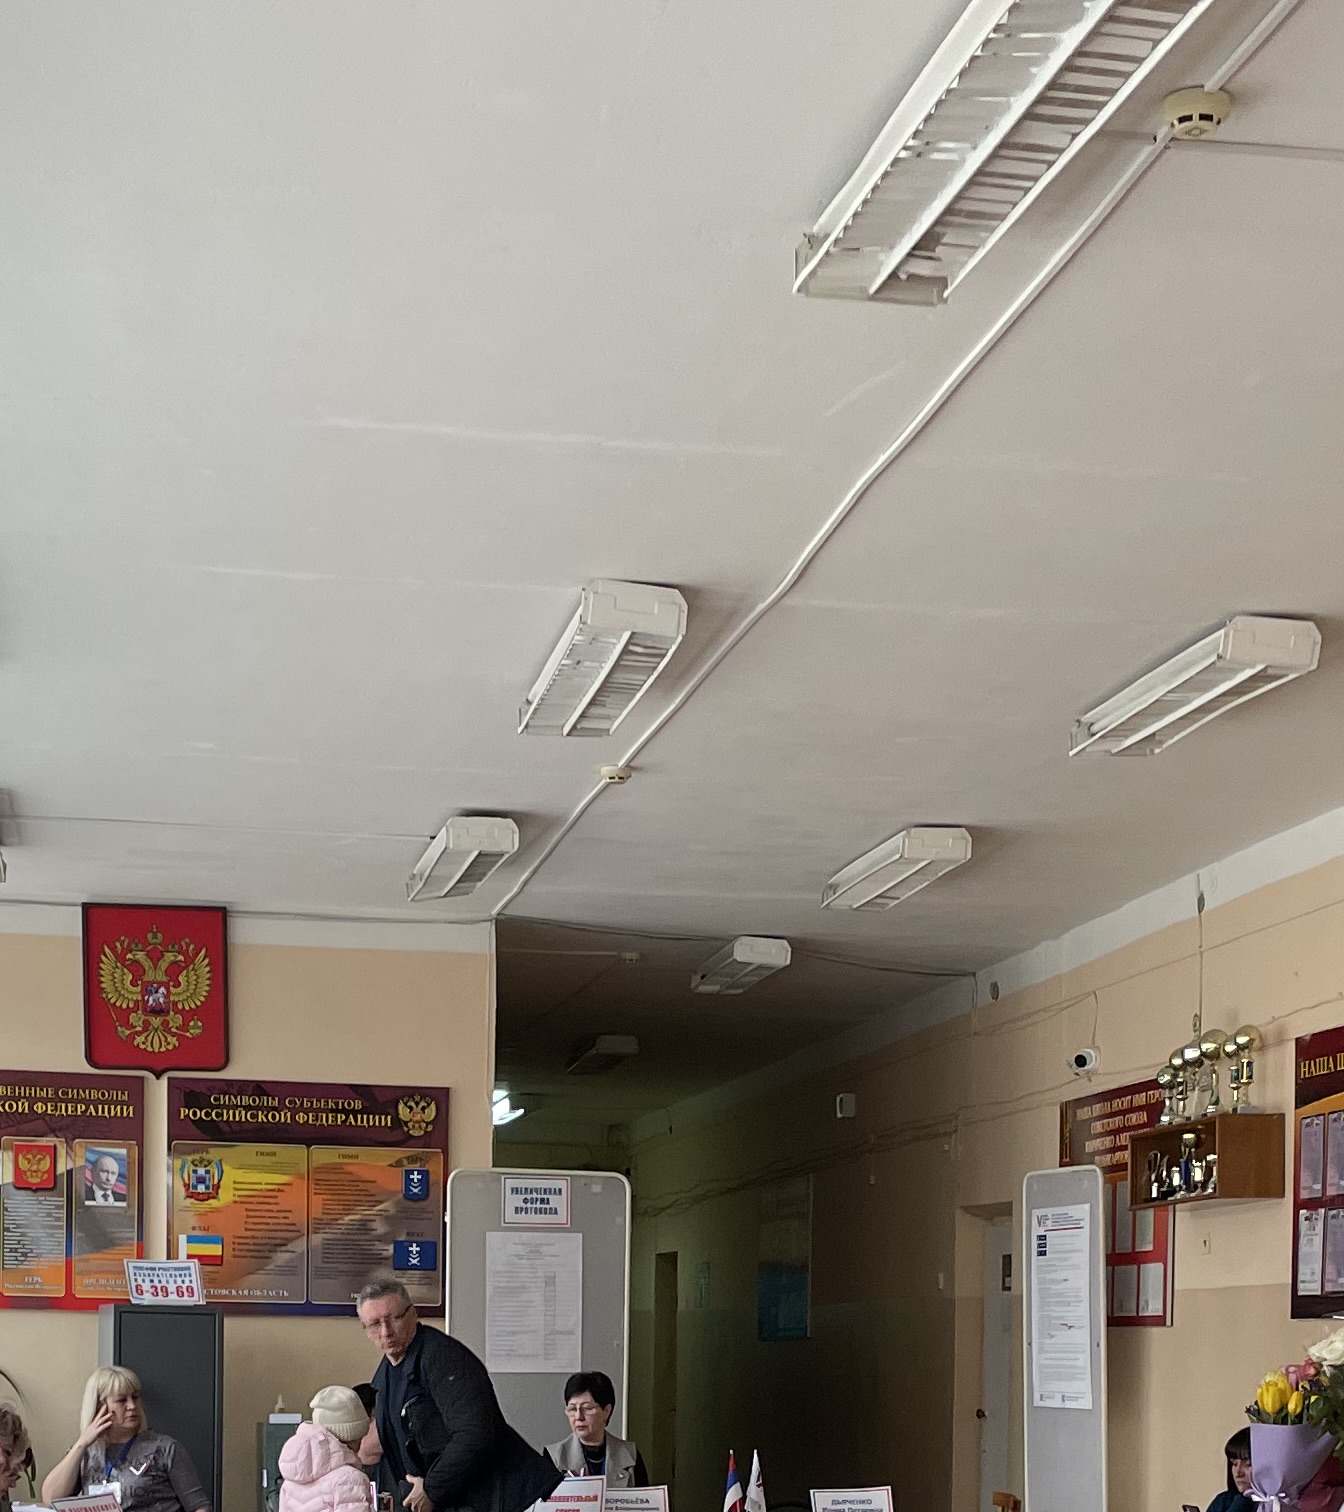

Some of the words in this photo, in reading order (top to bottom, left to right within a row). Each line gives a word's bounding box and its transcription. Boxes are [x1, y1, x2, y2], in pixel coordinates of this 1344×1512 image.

[1300, 1055, 1334, 1079] НАША
[58, 1087, 129, 1101] СИМВОЛЫ
[210, 1094, 279, 1108] СИМВОЛЫ
[285, 1097, 363, 1110] СУБЪЕКТОВ
[33, 1100, 135, 1118] ФЕДЕРАЦИИ
[180, 1108, 291, 1124] РОССИЙСКОЙ
[295, 1112, 392, 1128] ФЕДЕРАЦИИ
[135, 1284, 195, 1298] 6-39-69
